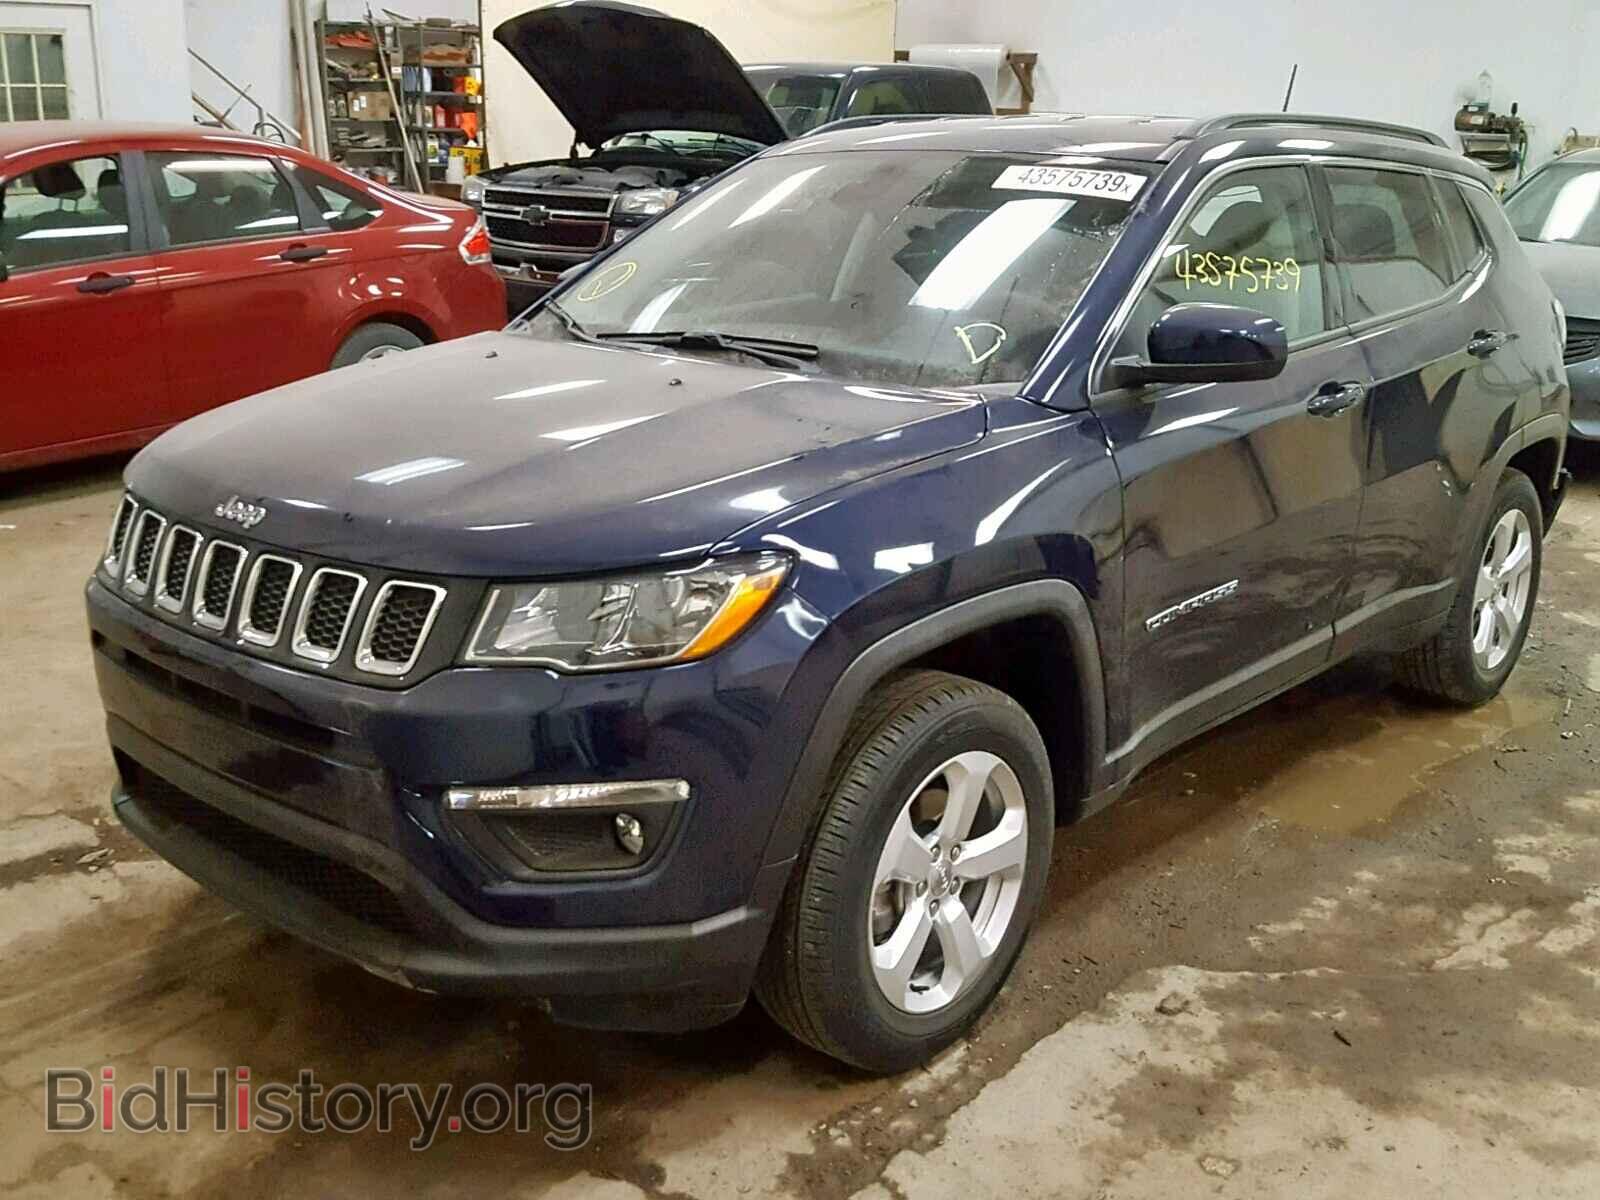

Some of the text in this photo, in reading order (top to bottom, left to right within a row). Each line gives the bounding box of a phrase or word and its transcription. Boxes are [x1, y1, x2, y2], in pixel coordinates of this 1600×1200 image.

[1175, 249, 1300, 293] 43575739
[953, 322, 1006, 364] D
[214, 495, 266, 529] Jeep
